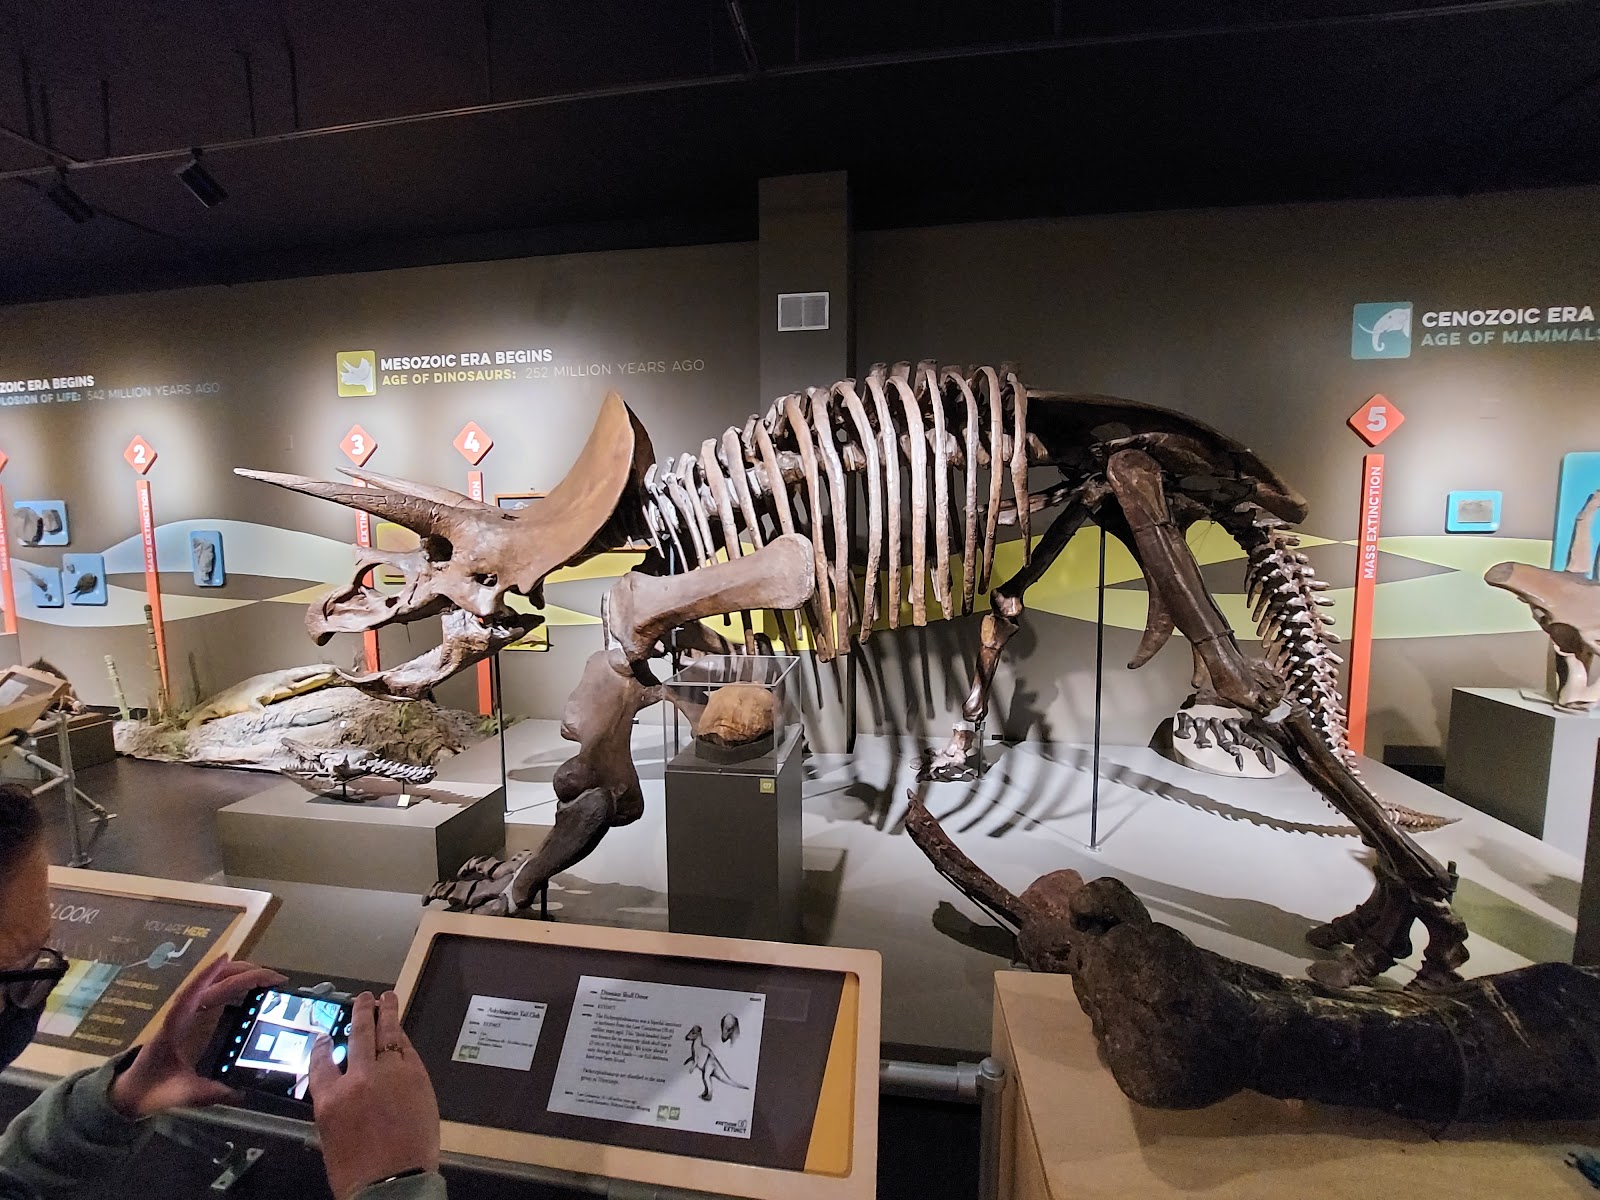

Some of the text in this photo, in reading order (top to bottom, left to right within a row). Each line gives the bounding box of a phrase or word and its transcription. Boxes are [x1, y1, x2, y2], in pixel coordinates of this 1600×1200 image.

[1421, 305, 1595, 328] CENOZOIC ERA
[1420, 332, 1461, 346] AGE
[1468, 331, 1495, 345] OF
[380, 348, 553, 371] MESOZOIC ERA BEGINS
[27, 379, 50, 391] ERA
[52, 375, 95, 390] BEGINS
[381, 359, 705, 386] AGE OF DINOSAURS: 252 MILLION YEARS AGO
[0, 382, 220, 406] LOSION OF LIFE: 542 MILLION YEARS AGO
[1366, 406, 1387, 432] 5
[351, 434, 365, 455] 3
[463, 431, 481, 453] 4
[133, 444, 146, 464] 2
[140, 488, 155, 573] MASS EXTINCTION
[1364, 466, 1382, 579] MASS EXTINCTION
